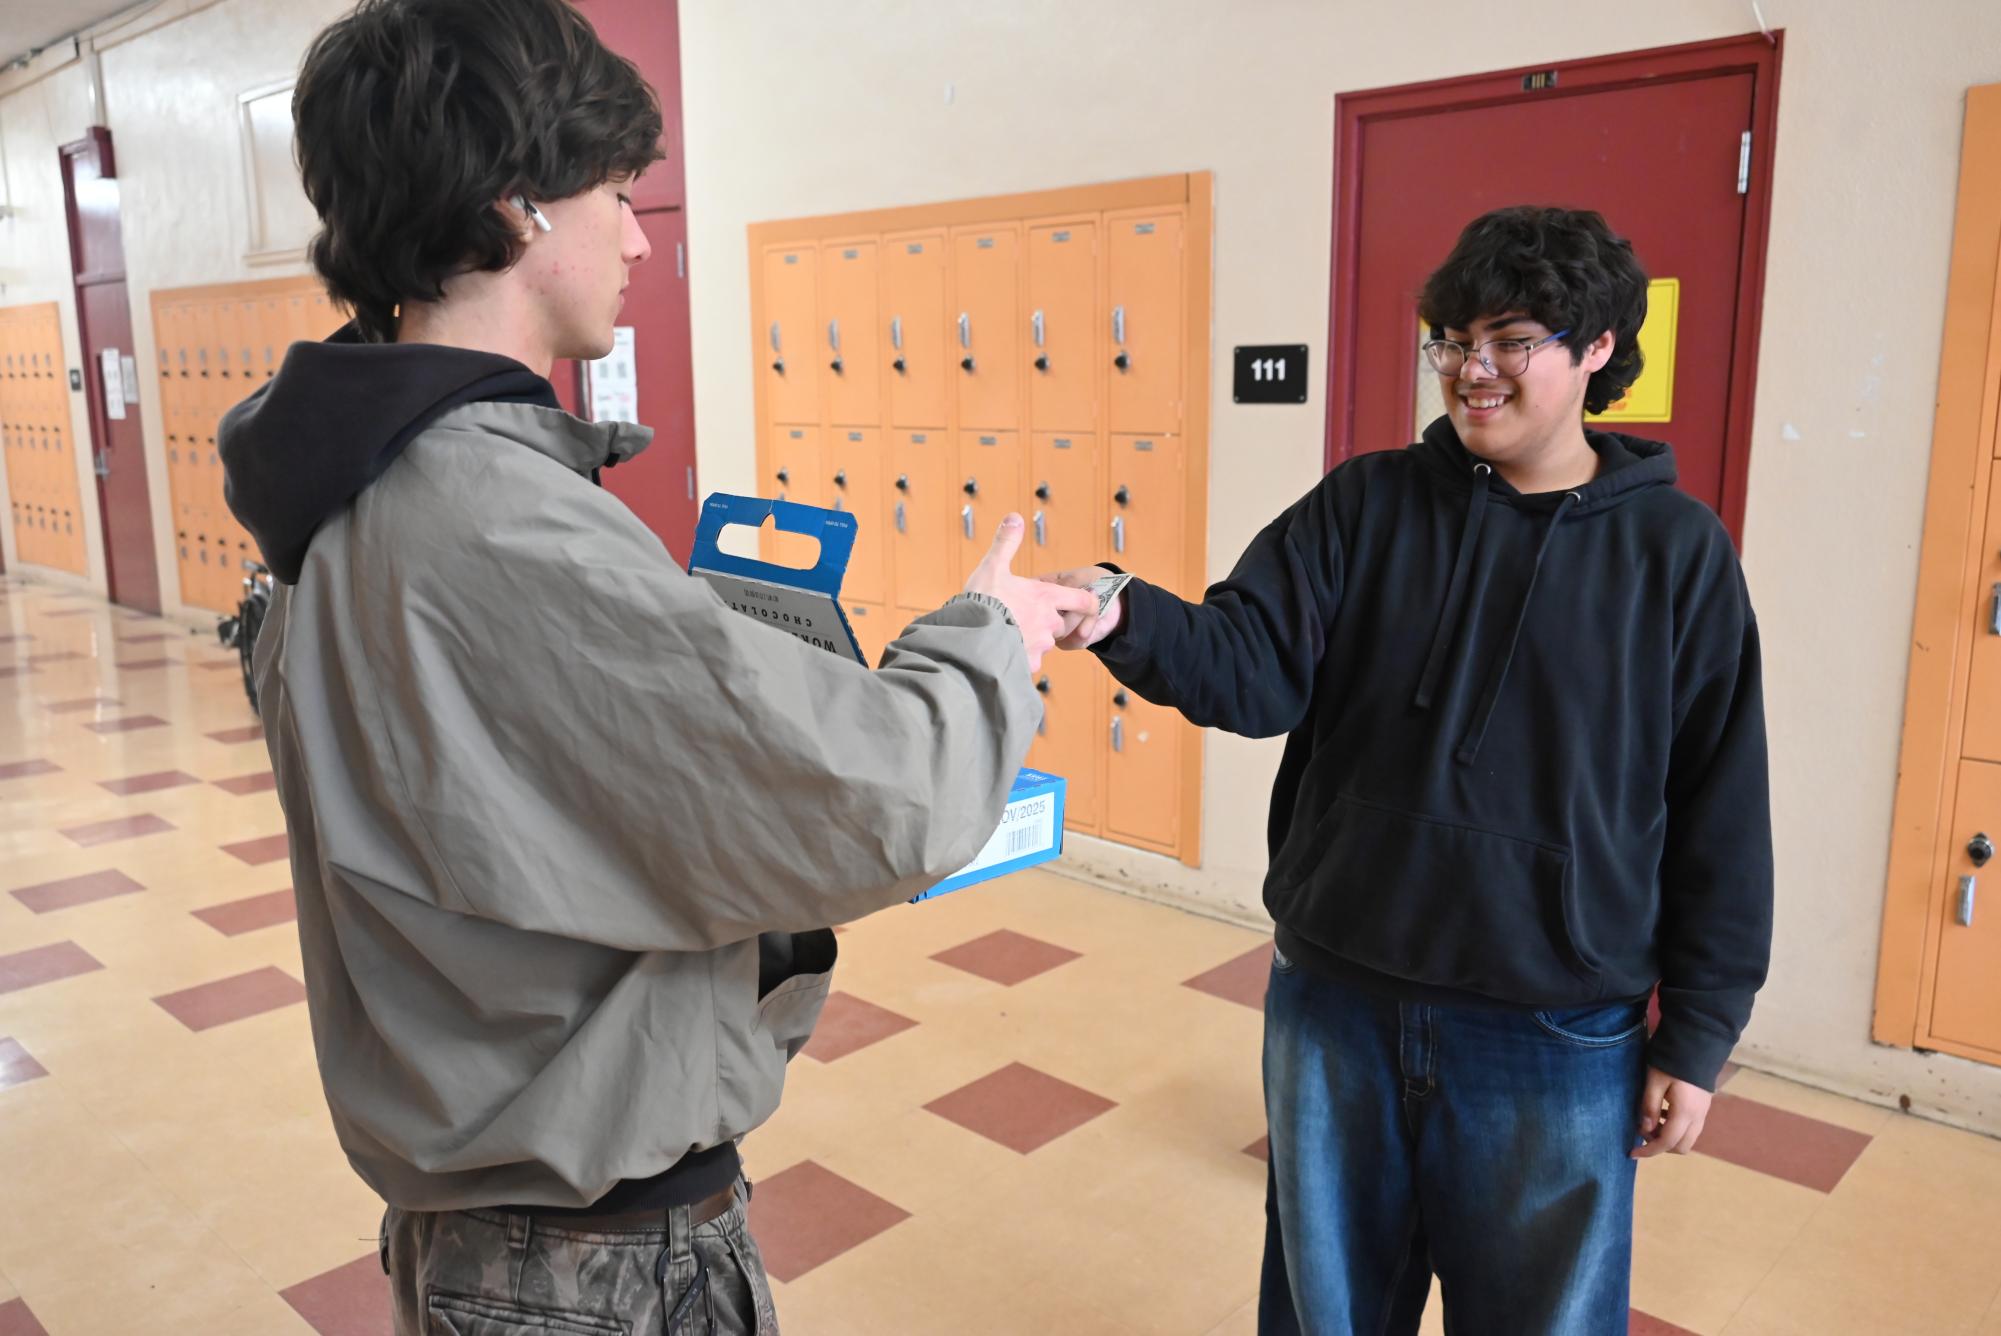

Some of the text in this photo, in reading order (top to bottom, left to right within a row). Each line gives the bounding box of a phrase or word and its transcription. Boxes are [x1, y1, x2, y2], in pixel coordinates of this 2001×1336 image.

[1251, 357, 1285, 381] 111
[725, 600, 812, 628] CHOCOLAT
[791, 631, 837, 654] WOR
